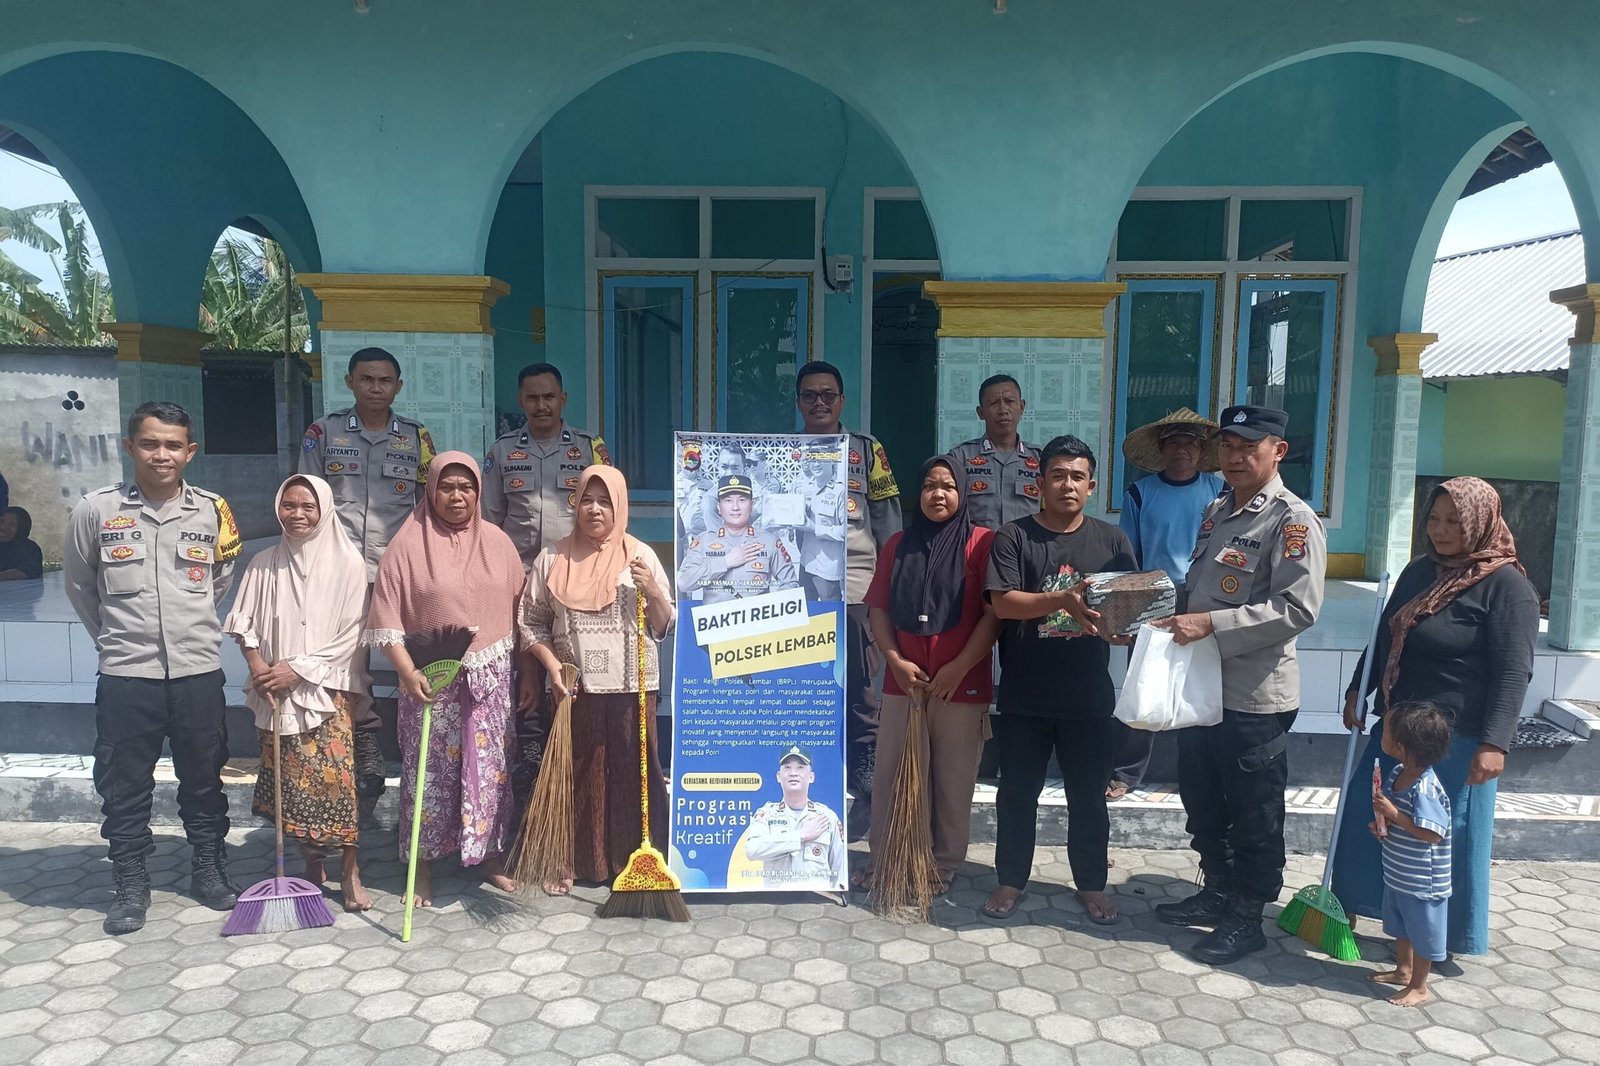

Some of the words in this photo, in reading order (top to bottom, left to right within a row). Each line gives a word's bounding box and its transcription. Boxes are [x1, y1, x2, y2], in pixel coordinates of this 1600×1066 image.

[326, 448, 359, 457] ARYANTO
[386, 452, 417, 463] POLRI
[101, 531, 125, 541] ERI
[131, 530, 142, 539] G
[180, 531, 216, 544] POLRI
[1231, 536, 1261, 550] POLRI
[697, 609, 746, 632] BAKTI
[750, 599, 802, 622] RELIGI
[714, 642, 772, 666] POLSEK
[776, 630, 836, 654] LEMBAR
[703, 678, 719, 687] Religi
[682, 688, 709, 696] Program
[778, 689, 813, 697] masyarakat
[812, 699, 836, 707] sebagai
[694, 719, 717, 727] kepada
[719, 719, 755, 727] masyarakat
[724, 729, 759, 737] menyentuh
[761, 729, 789, 738] langsung
[682, 739, 709, 747] sehingga
[758, 739, 798, 747] kepercayaan
[681, 749, 705, 757] kepada
[677, 798, 751, 814] Program
[676, 813, 753, 826] Innovasi
[676, 829, 733, 845] Kreatif
